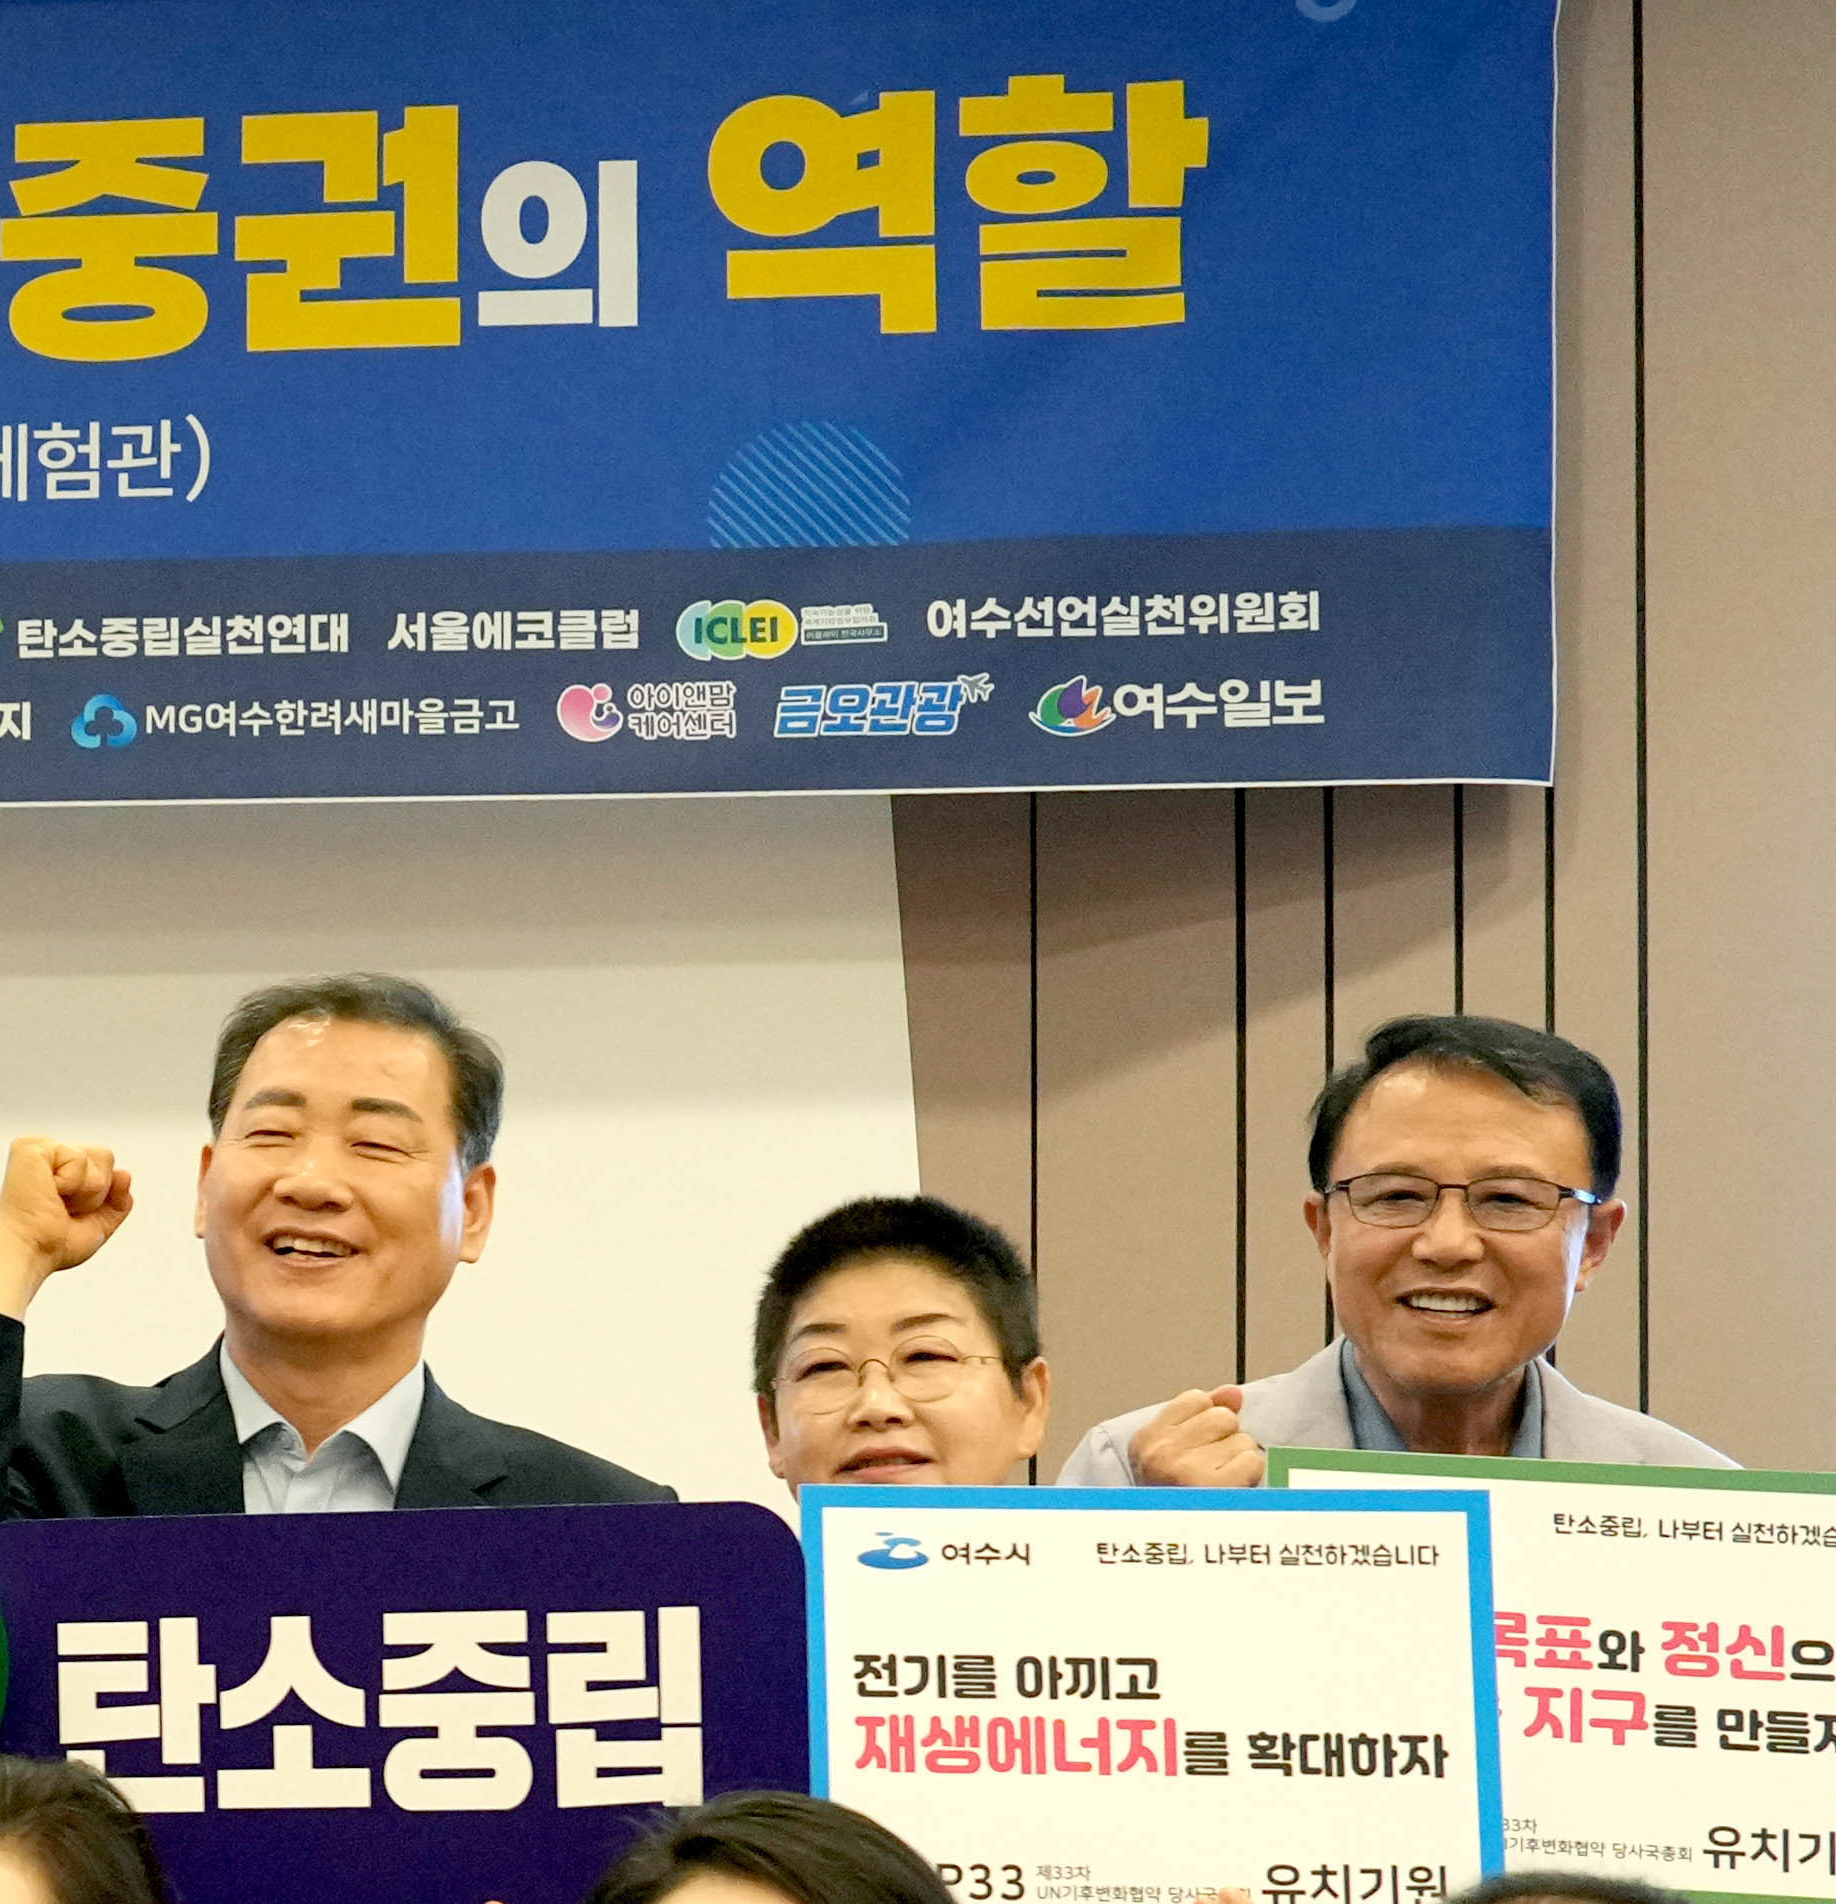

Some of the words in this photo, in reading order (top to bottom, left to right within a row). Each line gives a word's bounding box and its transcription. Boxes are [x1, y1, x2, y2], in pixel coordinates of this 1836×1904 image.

[708, 73, 1209, 334] 역할
[18, 613, 348, 658] 탄소중립실천연대
[388, 609, 638, 651] 서울에코클럽
[693, 617, 778, 645] ICLEI
[927, 591, 1319, 638] 여수선언실천위원회
[146, 698, 519, 736] MG여수한려새마을금고
[626, 679, 735, 710] 아이앤맘
[772, 681, 968, 737] 금오관광
[1115, 678, 1325, 730] 여수일보
[626, 709, 737, 742] 케어센터
[942, 1543, 1030, 1566] 여수시
[854, 1654, 996, 1699] 전기를
[1016, 1656, 1161, 1700] 아끼고
[57, 1606, 704, 1813] 탄소중립
[1524, 1687, 1698, 1748] 지구를
[855, 1714, 1230, 1776] 재생에너지를
[1247, 1731, 1449, 1778] 확대하자
